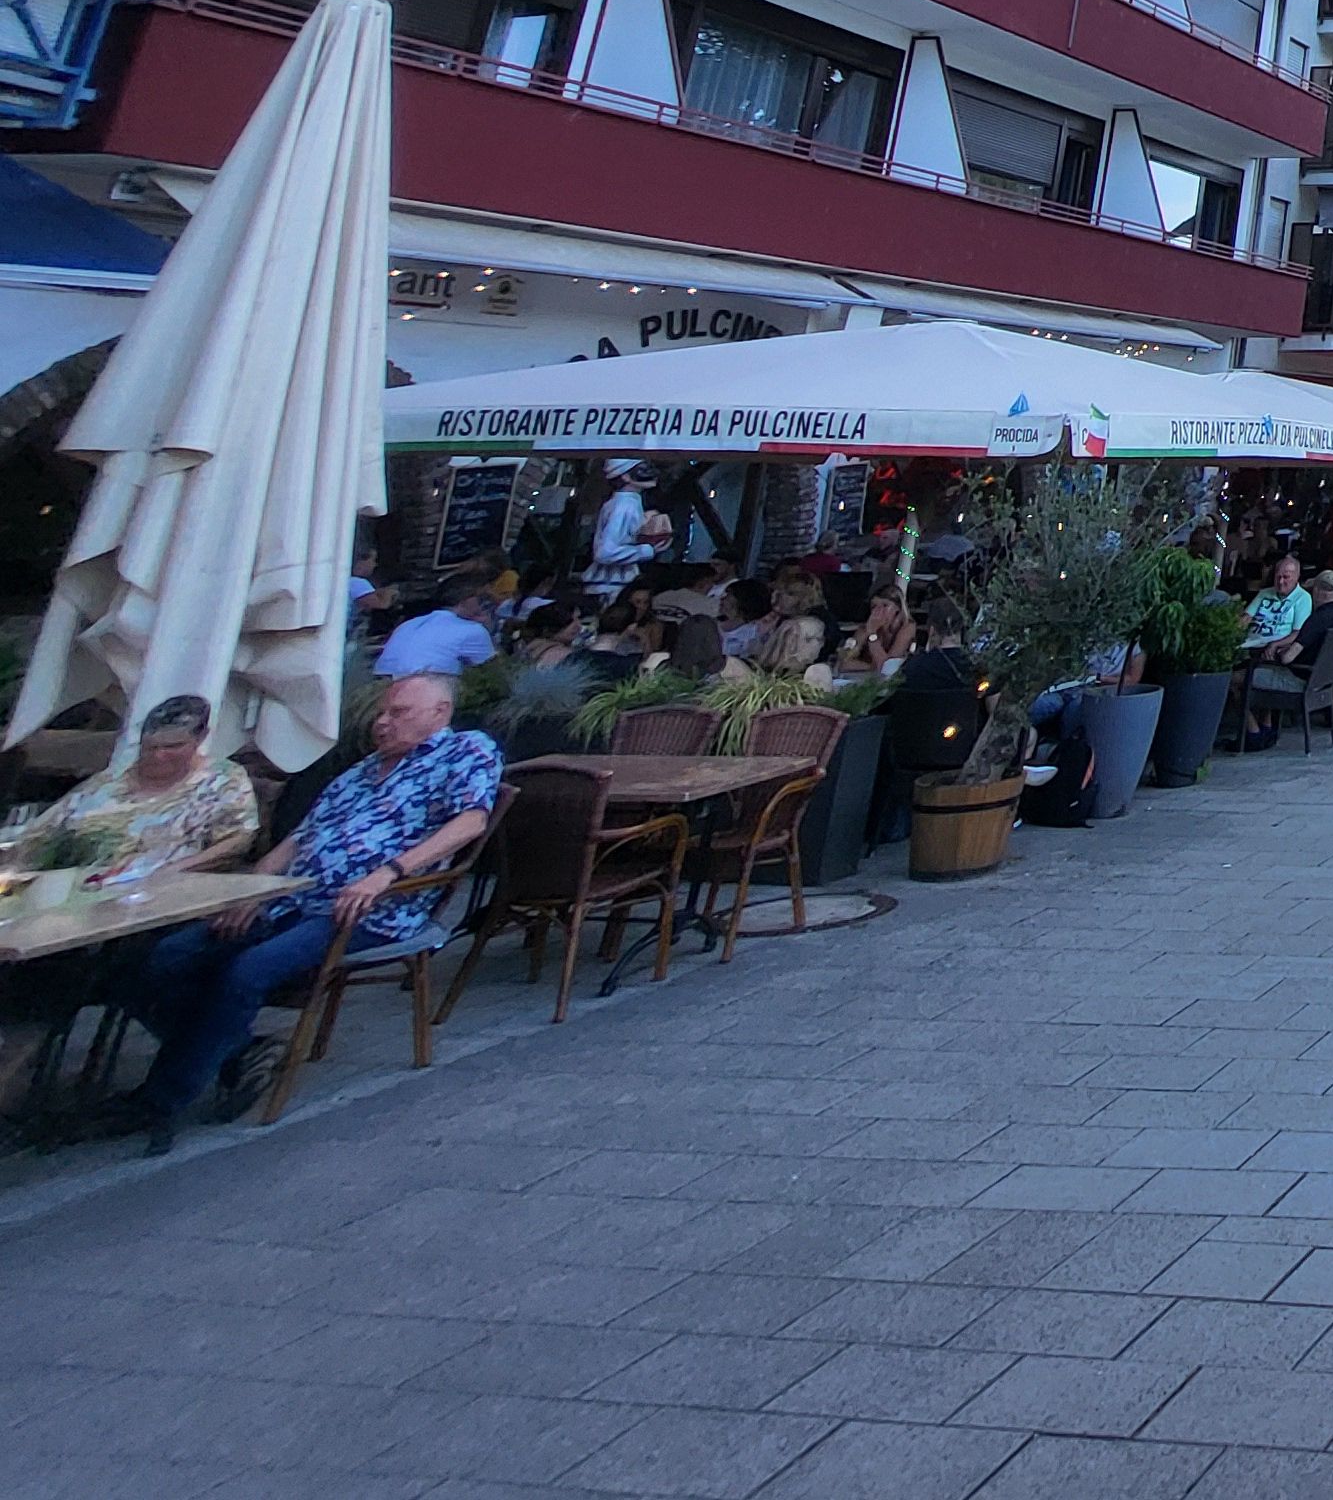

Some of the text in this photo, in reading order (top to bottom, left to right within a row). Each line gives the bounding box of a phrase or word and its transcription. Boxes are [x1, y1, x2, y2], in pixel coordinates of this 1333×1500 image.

[437, 408, 867, 440] RISTORANTE PIZZERIA DA PULCINELLA
[994, 427, 1039, 443] PROCIDA
[1171, 420, 1235, 445] RISTORANTE
[1280, 423, 1292, 447] DA
